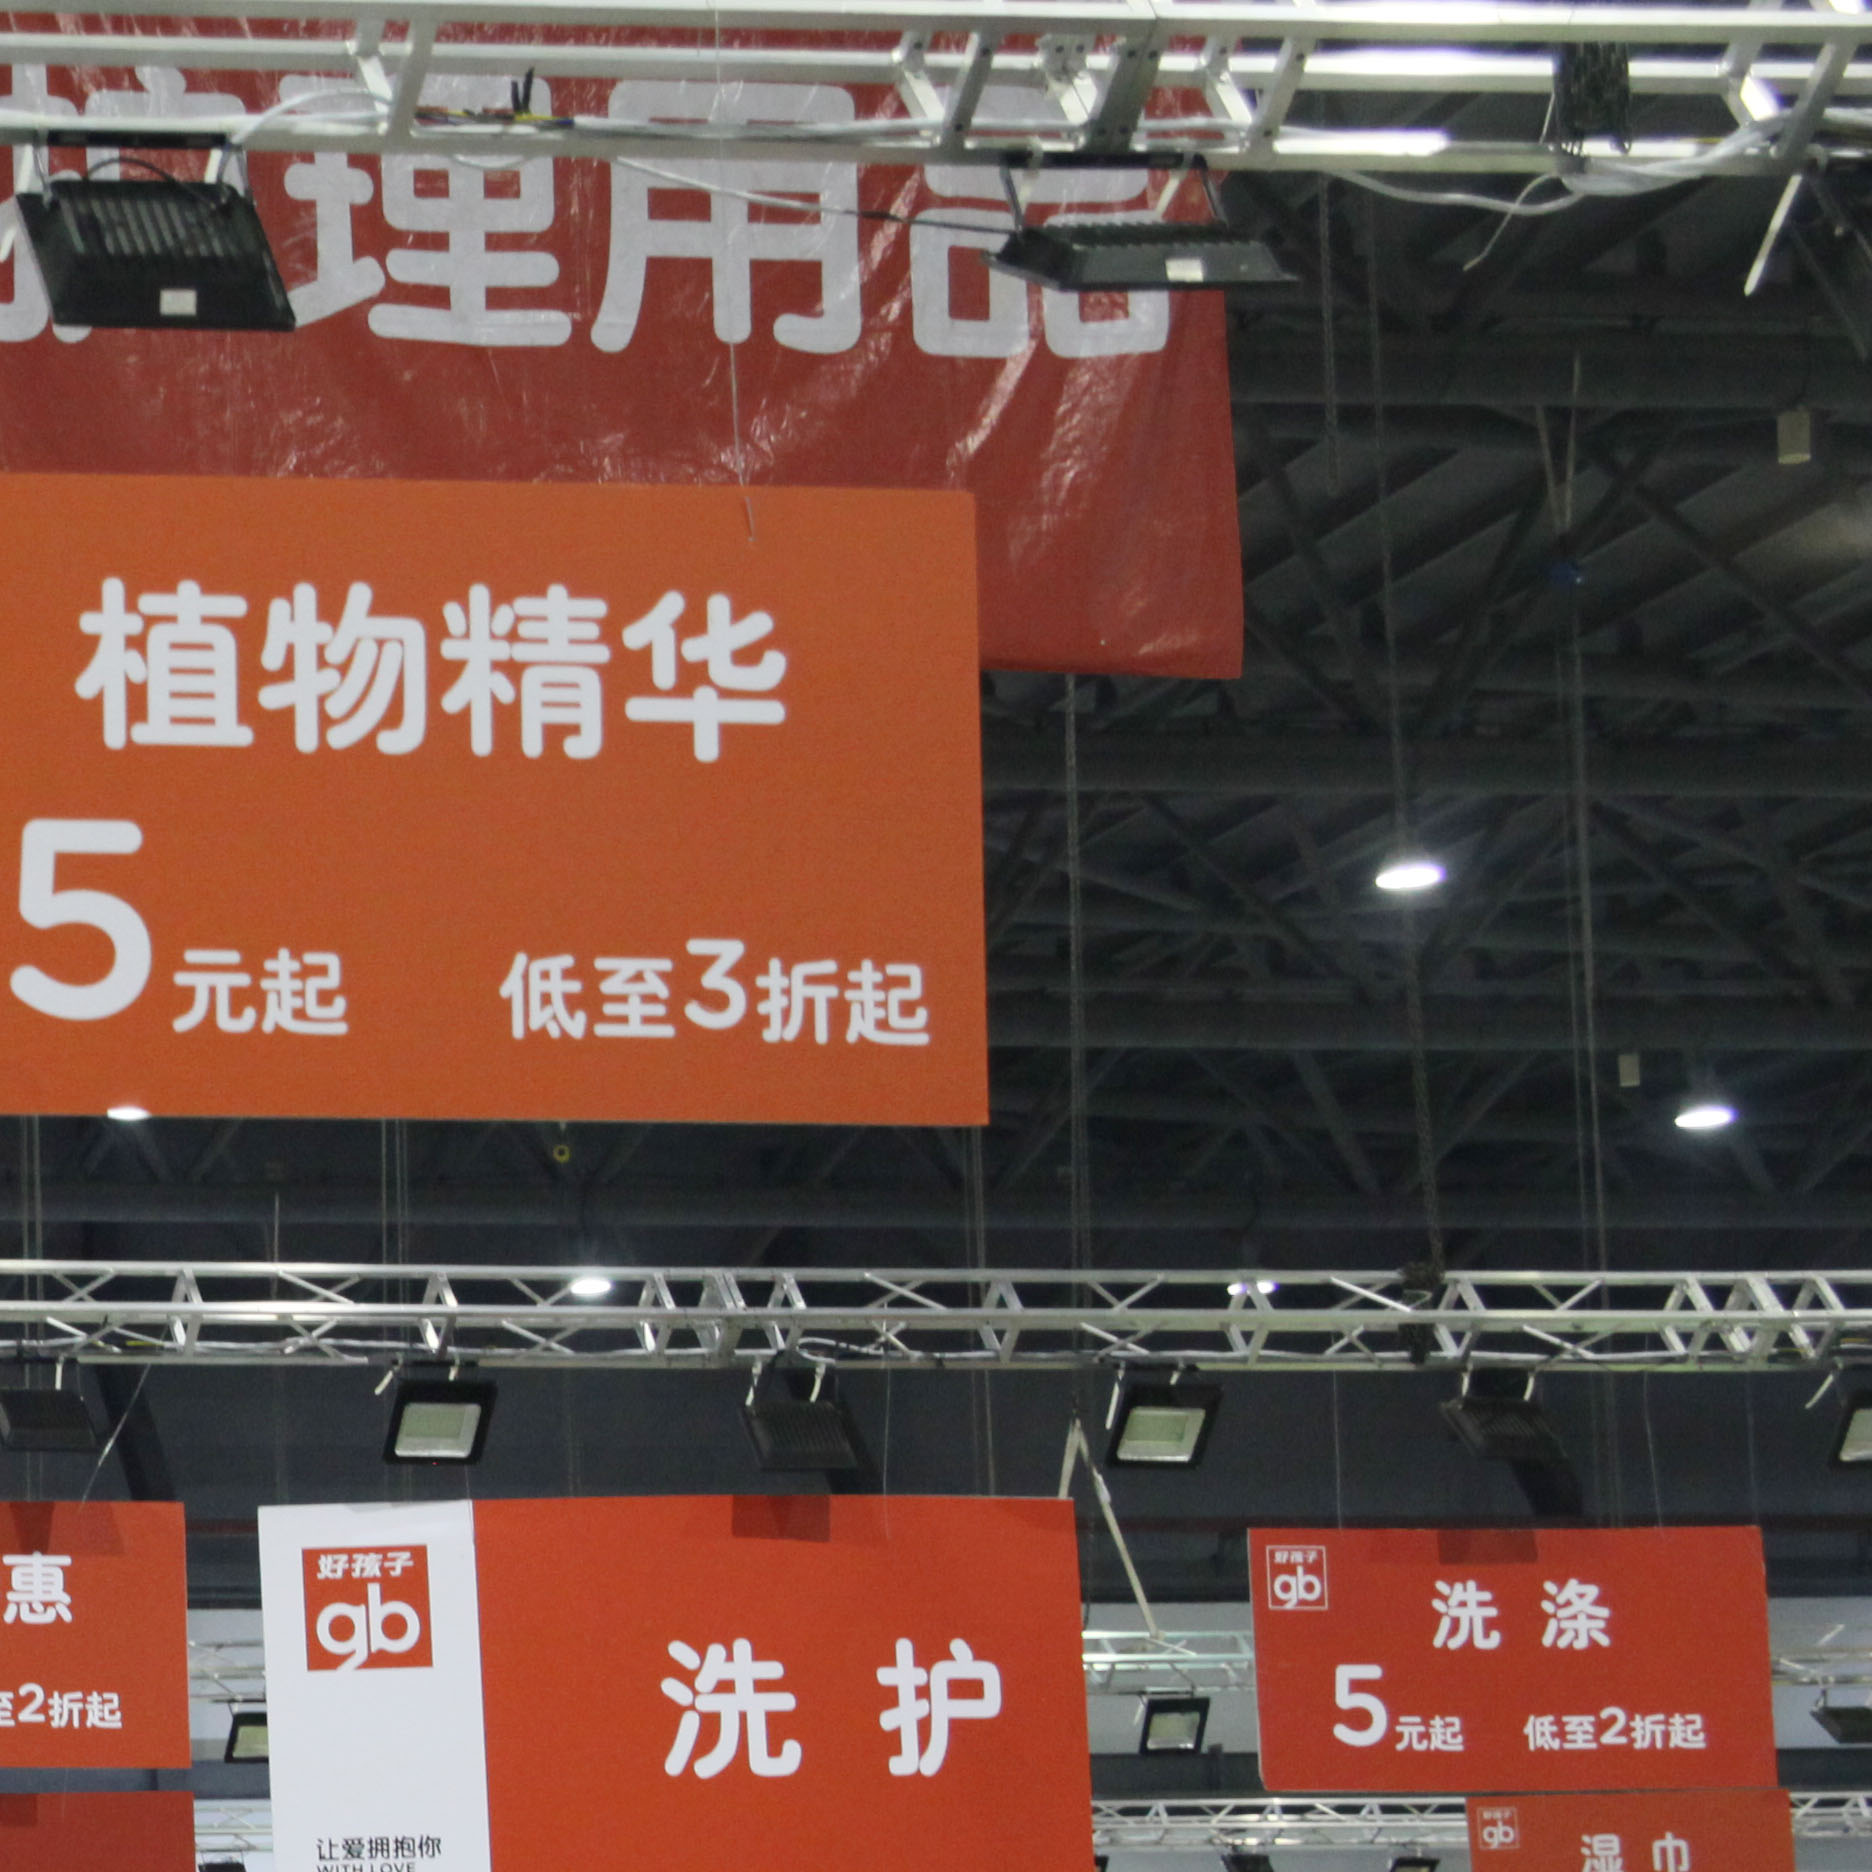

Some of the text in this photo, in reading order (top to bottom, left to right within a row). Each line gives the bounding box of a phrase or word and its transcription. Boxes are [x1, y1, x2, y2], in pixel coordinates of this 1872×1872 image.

[75, 578, 786, 762] 植物精华
[10, 819, 929, 1045] 5元起 低至3折起
[317, 1552, 413, 1579] 好孩子
[1273, 1565, 1322, 1607] gb
[315, 1583, 421, 1671] gb
[1432, 1579, 1610, 1649] 洗涤
[661, 1638, 1001, 1779] 洗护
[1333, 1664, 1706, 1751] 5元起 低至2折起
[317, 1836, 441, 1862] 让爱拥抱你
